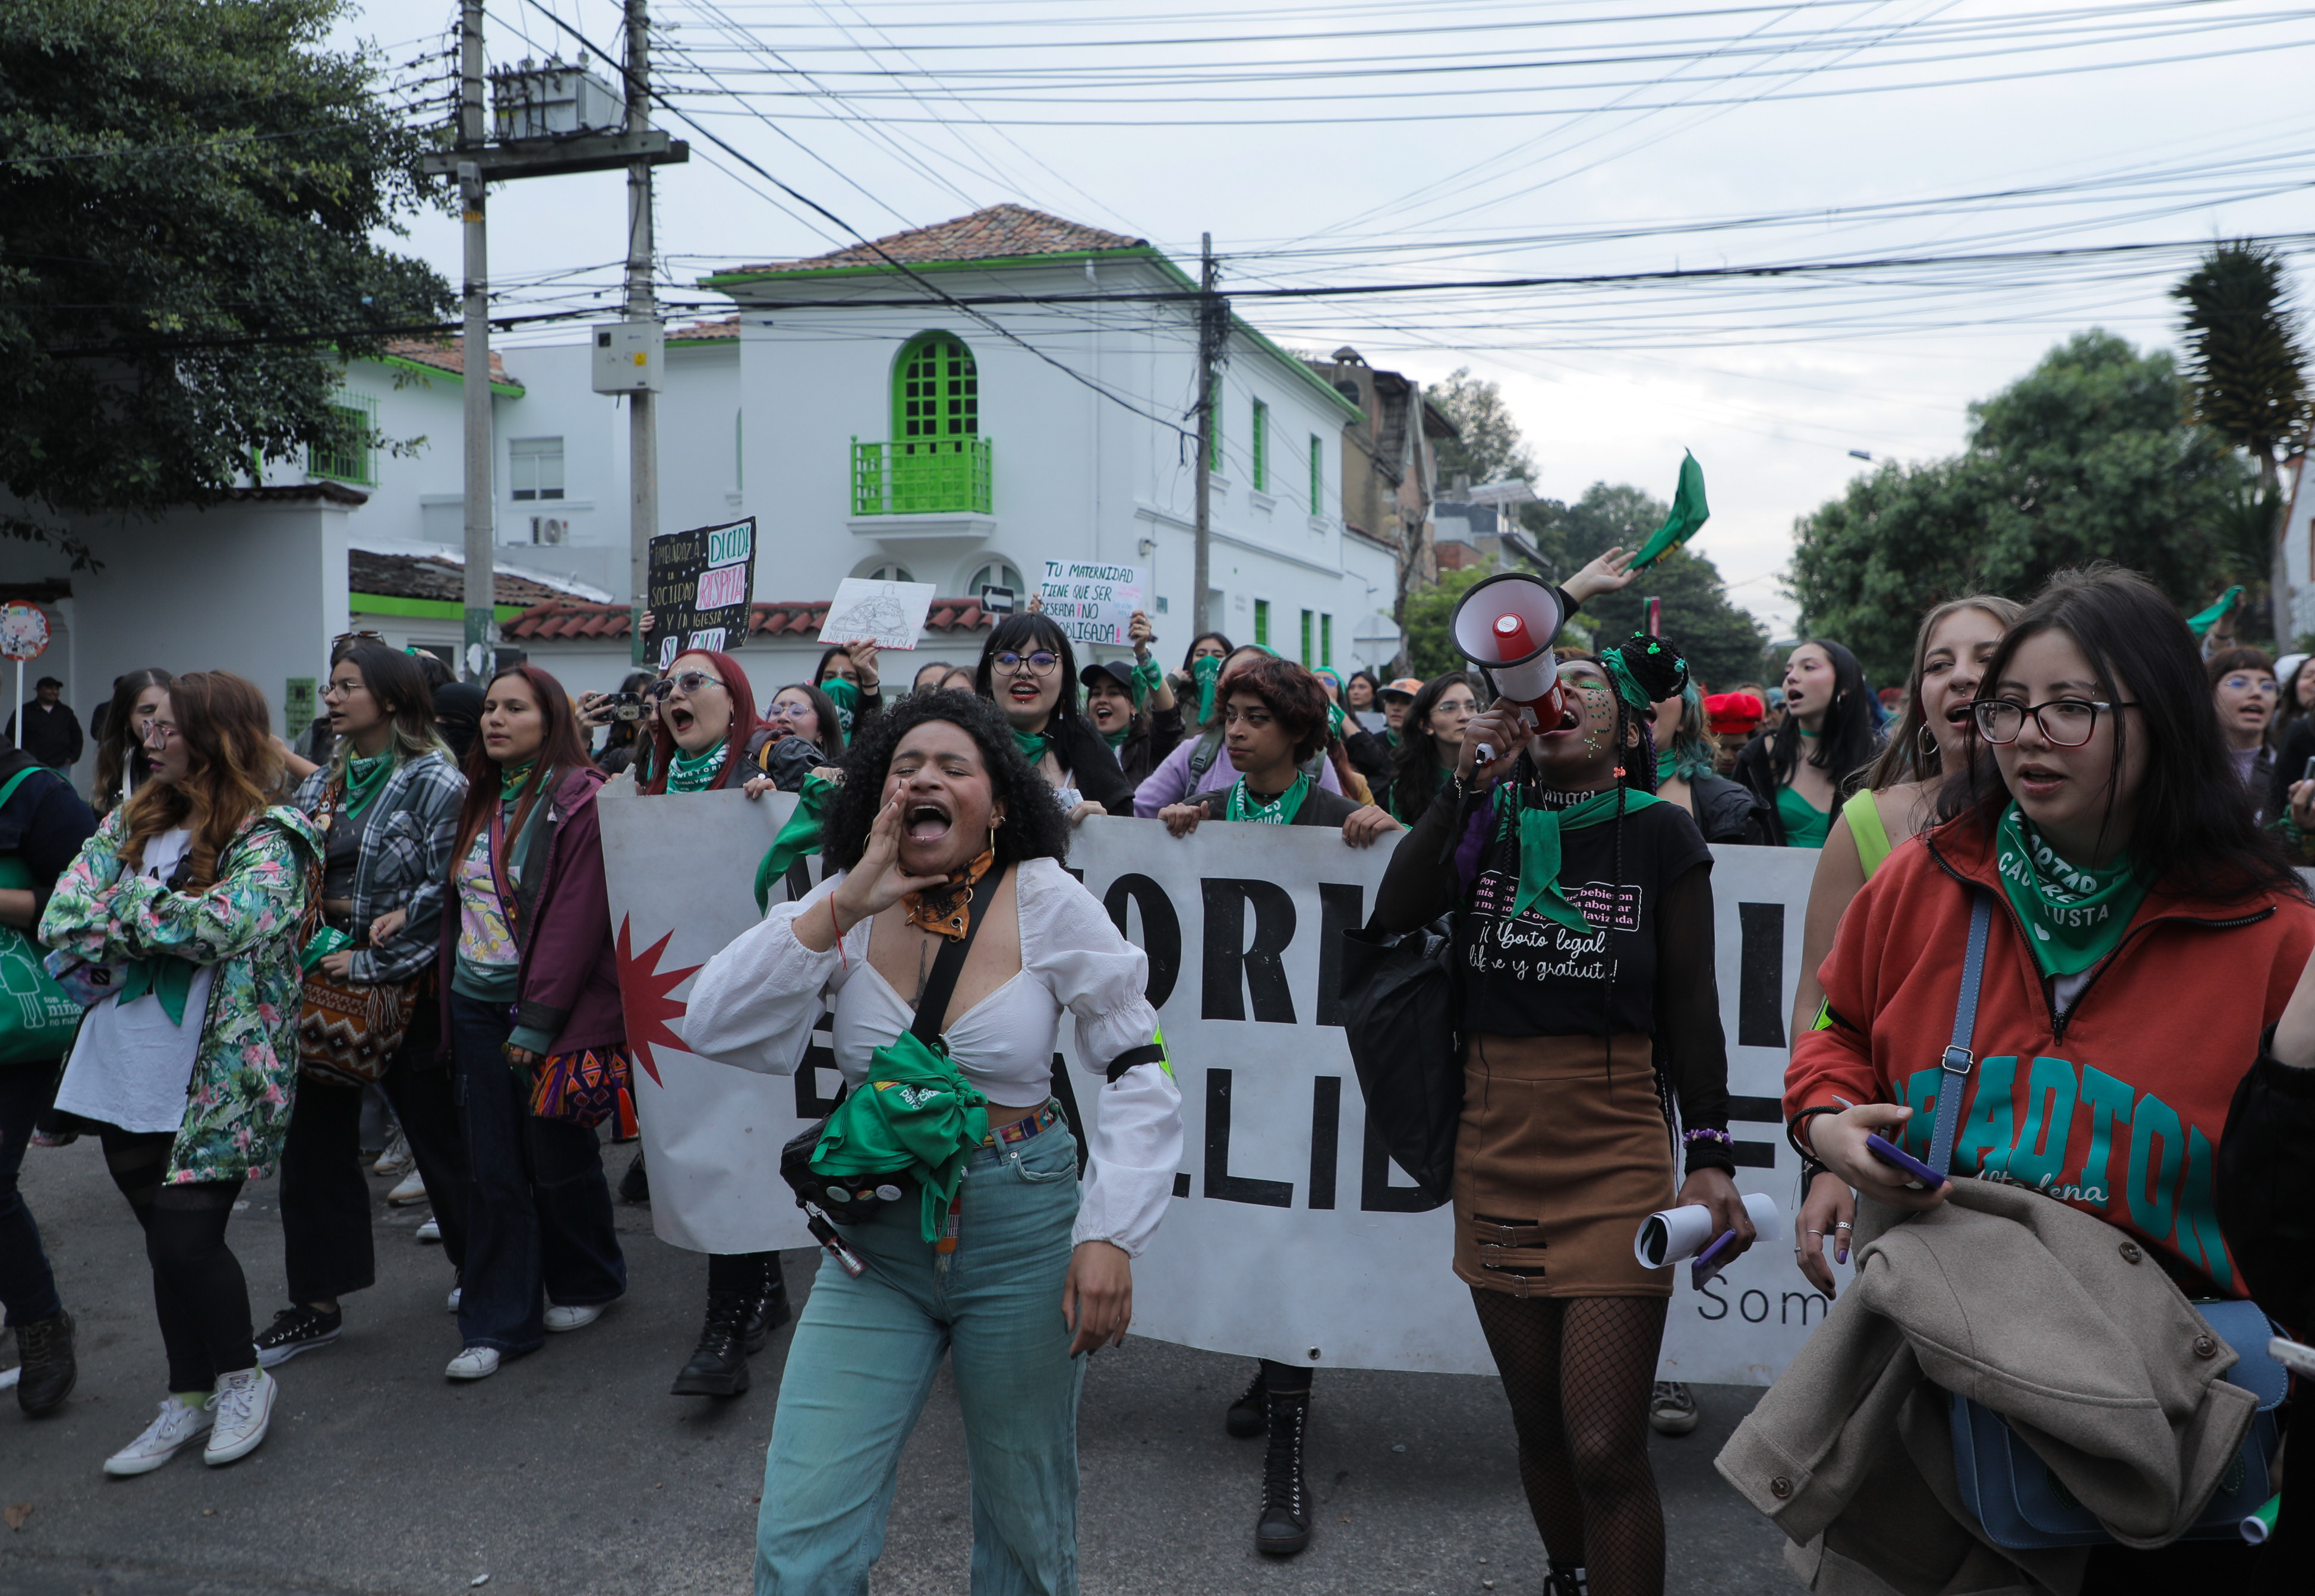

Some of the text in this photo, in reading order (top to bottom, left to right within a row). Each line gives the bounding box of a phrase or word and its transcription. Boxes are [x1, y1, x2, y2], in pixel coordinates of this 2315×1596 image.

[1046, 562, 1134, 583] TU MATERNIDAD
[651, 582, 695, 607] SOCIEDAD
[1042, 583, 1070, 598] TIENE
[1073, 585, 1090, 600] QUE
[1092, 585, 1112, 601] SER
[667, 614, 674, 630] Y
[693, 610, 722, 627] IGLESIA
[1998, 852, 2030, 886] CAU
[1480, 877, 1496, 886] Por
[1477, 890, 1494, 898] mis
[1585, 901, 1631, 912] aborar
[1556, 928, 1606, 959] legal
[1513, 960, 1529, 980] y
